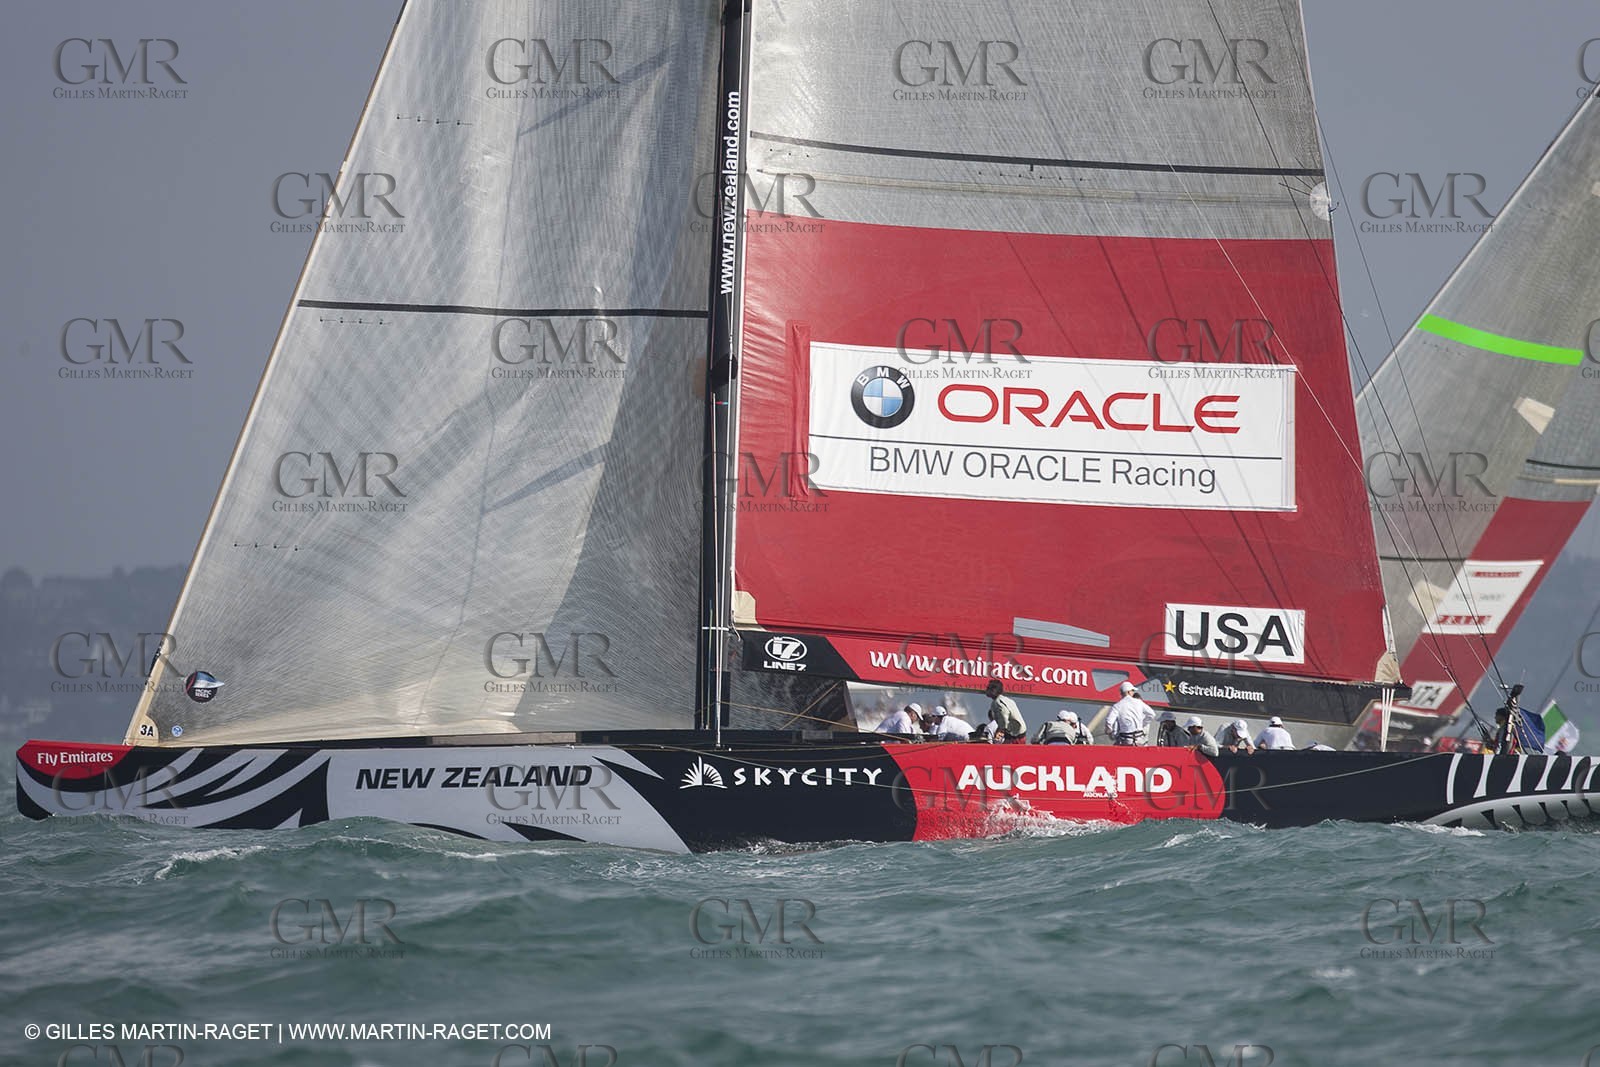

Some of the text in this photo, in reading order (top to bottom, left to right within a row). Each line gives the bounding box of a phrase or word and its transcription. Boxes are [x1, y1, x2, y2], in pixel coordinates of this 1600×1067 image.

[720, 90, 741, 295] www.newzealand.com
[856, 366, 911, 389] BMW
[937, 383, 1241, 434] ORACLE
[869, 445, 1217, 494] BMW ORACLE Racing
[1174, 609, 1295, 657] USA
[868, 650, 1088, 687] www.emirates.com
[140, 724, 154, 737] 3A
[37, 750, 113, 767] Fly Emirates
[355, 765, 593, 790] NEW ZEALAND
[733, 766, 883, 787] SKYCITY
[956, 764, 1173, 793] AUCKLAND
